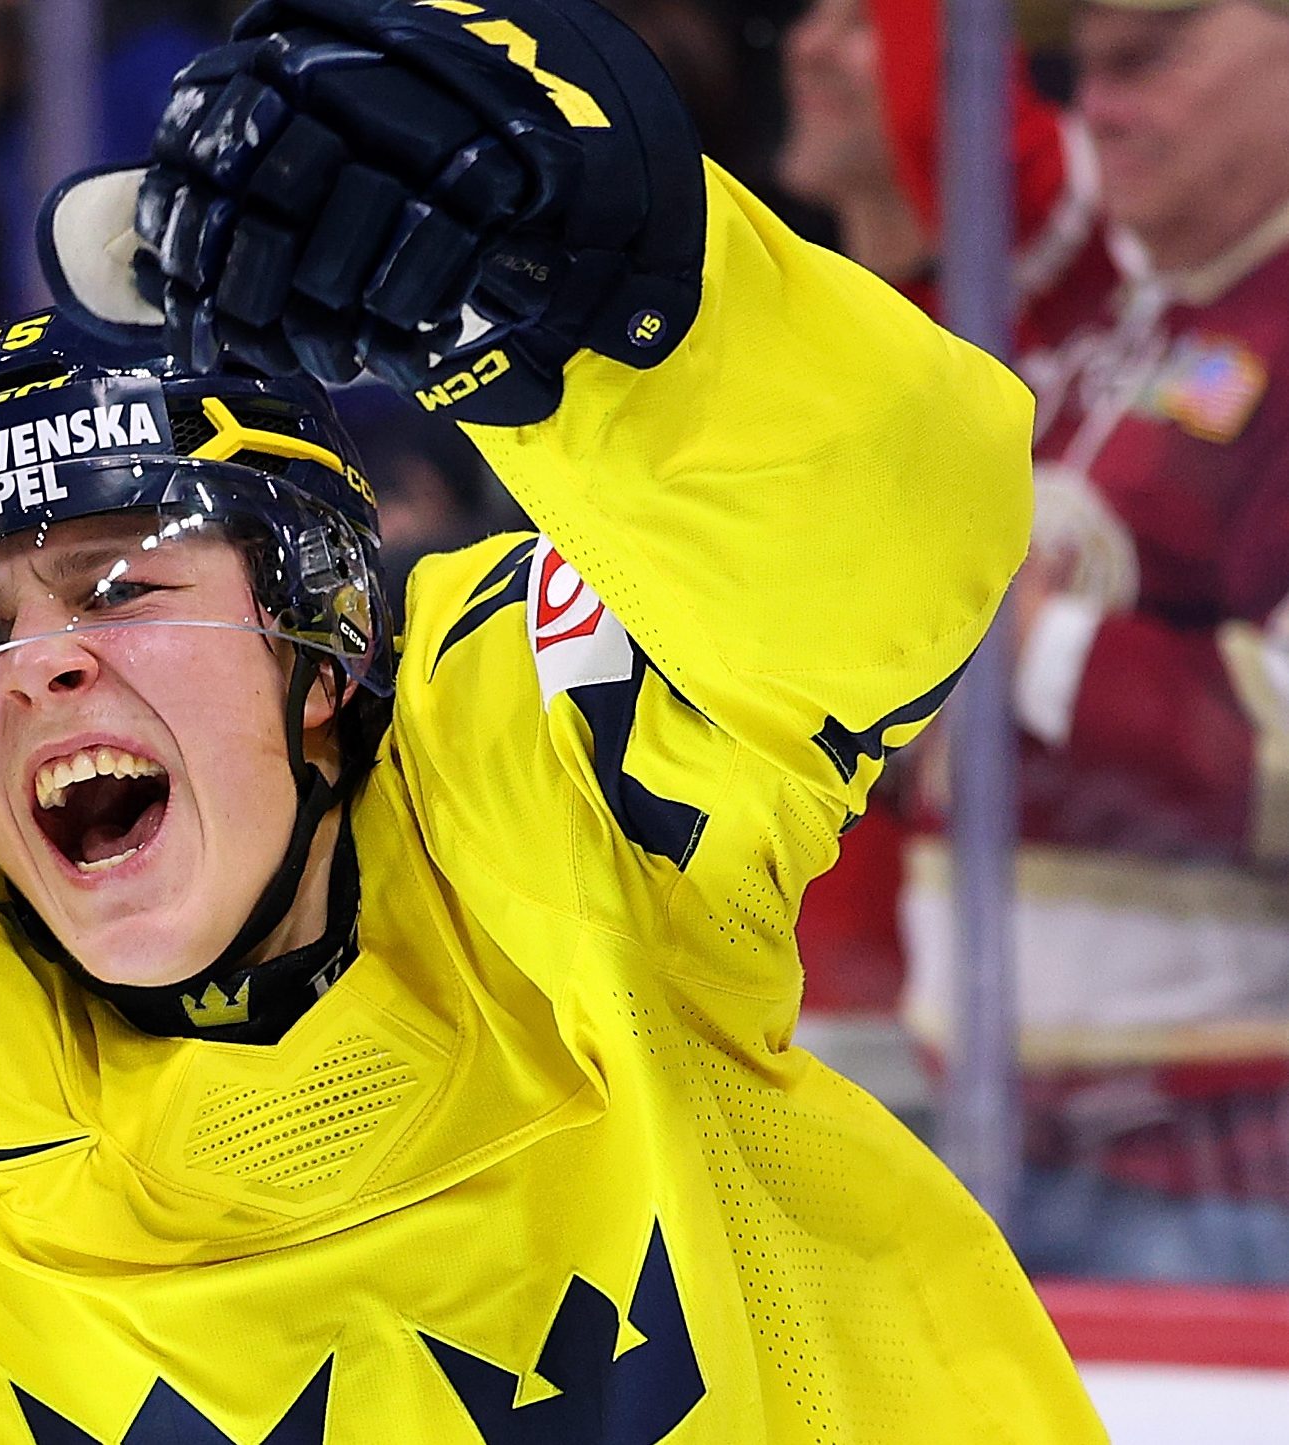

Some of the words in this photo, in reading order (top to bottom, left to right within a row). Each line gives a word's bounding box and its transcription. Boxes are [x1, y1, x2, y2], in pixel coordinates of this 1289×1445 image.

[635, 314, 661, 340] 15
[415, 350, 510, 412] CCM
[340, 621, 366, 651] CCM
